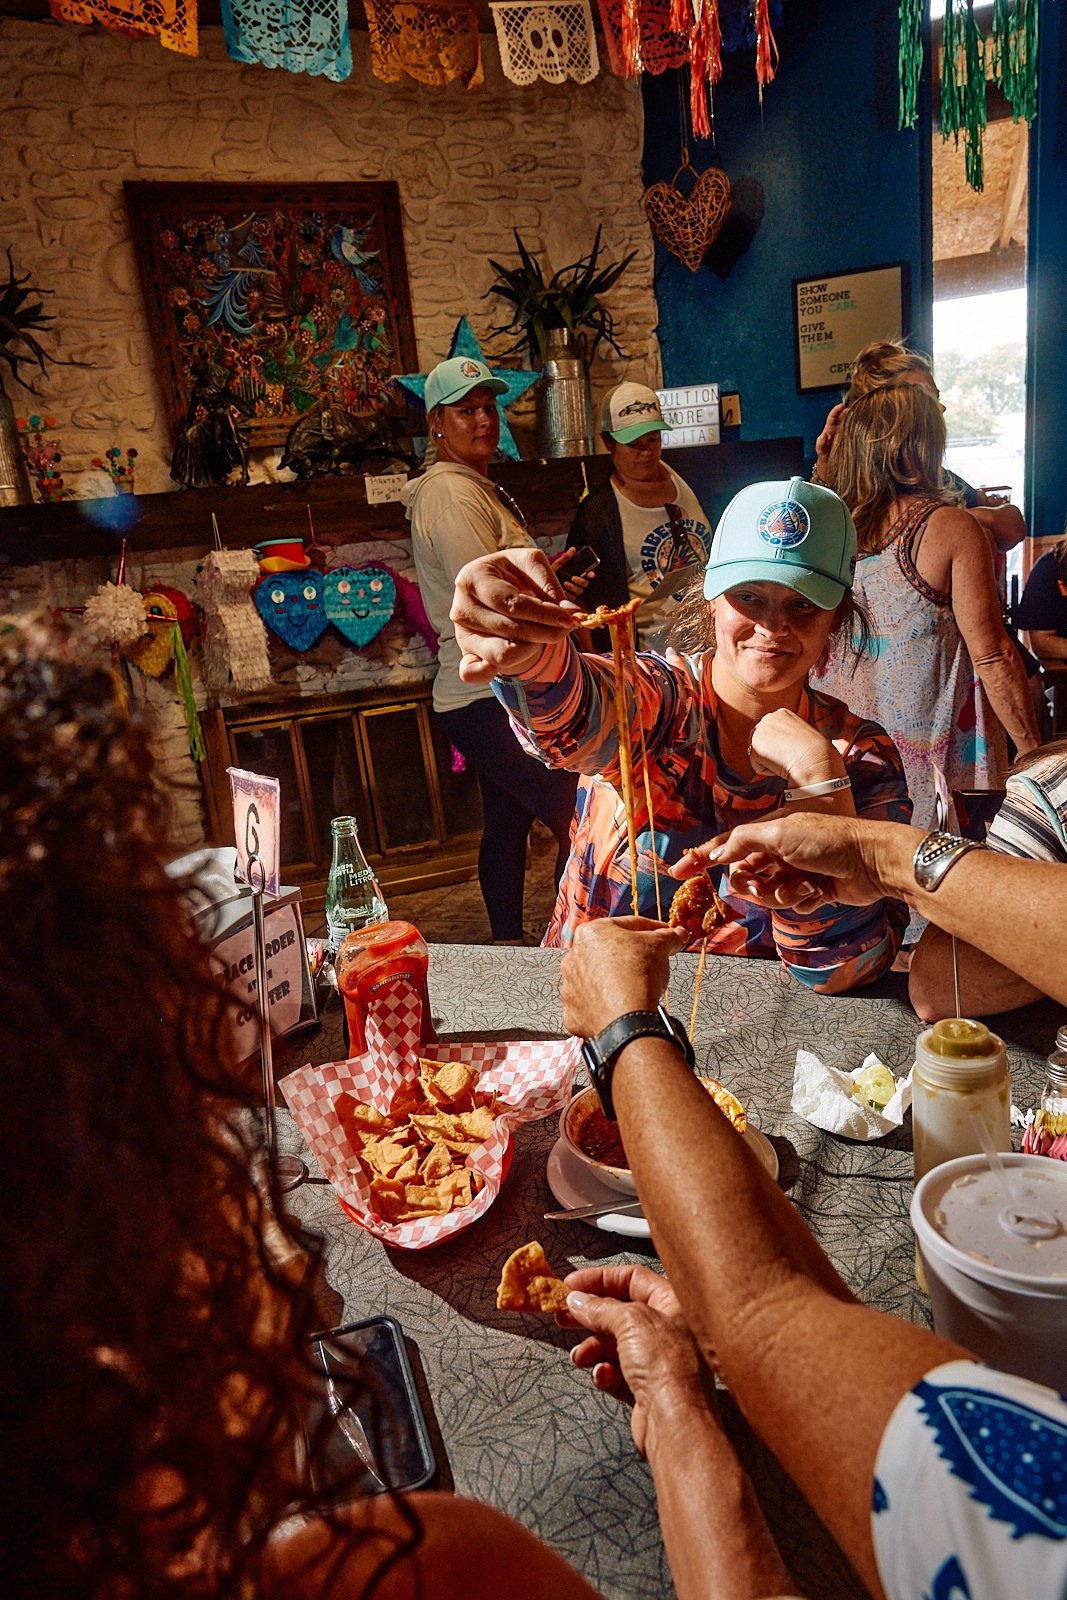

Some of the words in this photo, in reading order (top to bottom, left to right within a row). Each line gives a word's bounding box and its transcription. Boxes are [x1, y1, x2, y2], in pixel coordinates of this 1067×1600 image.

[800, 283, 828, 296] SHOW
[800, 290, 850, 306] SOMEONE
[800, 305, 822, 316] YOU
[800, 322, 825, 333] GIVE
[801, 331, 833, 343] THEM
[662, 428, 715, 446] OSITAS
[760, 501, 787, 525] BABES
[246, 802, 260, 858] 6
[264, 929, 295, 961] RDER
[235, 980, 290, 1027] COTER
